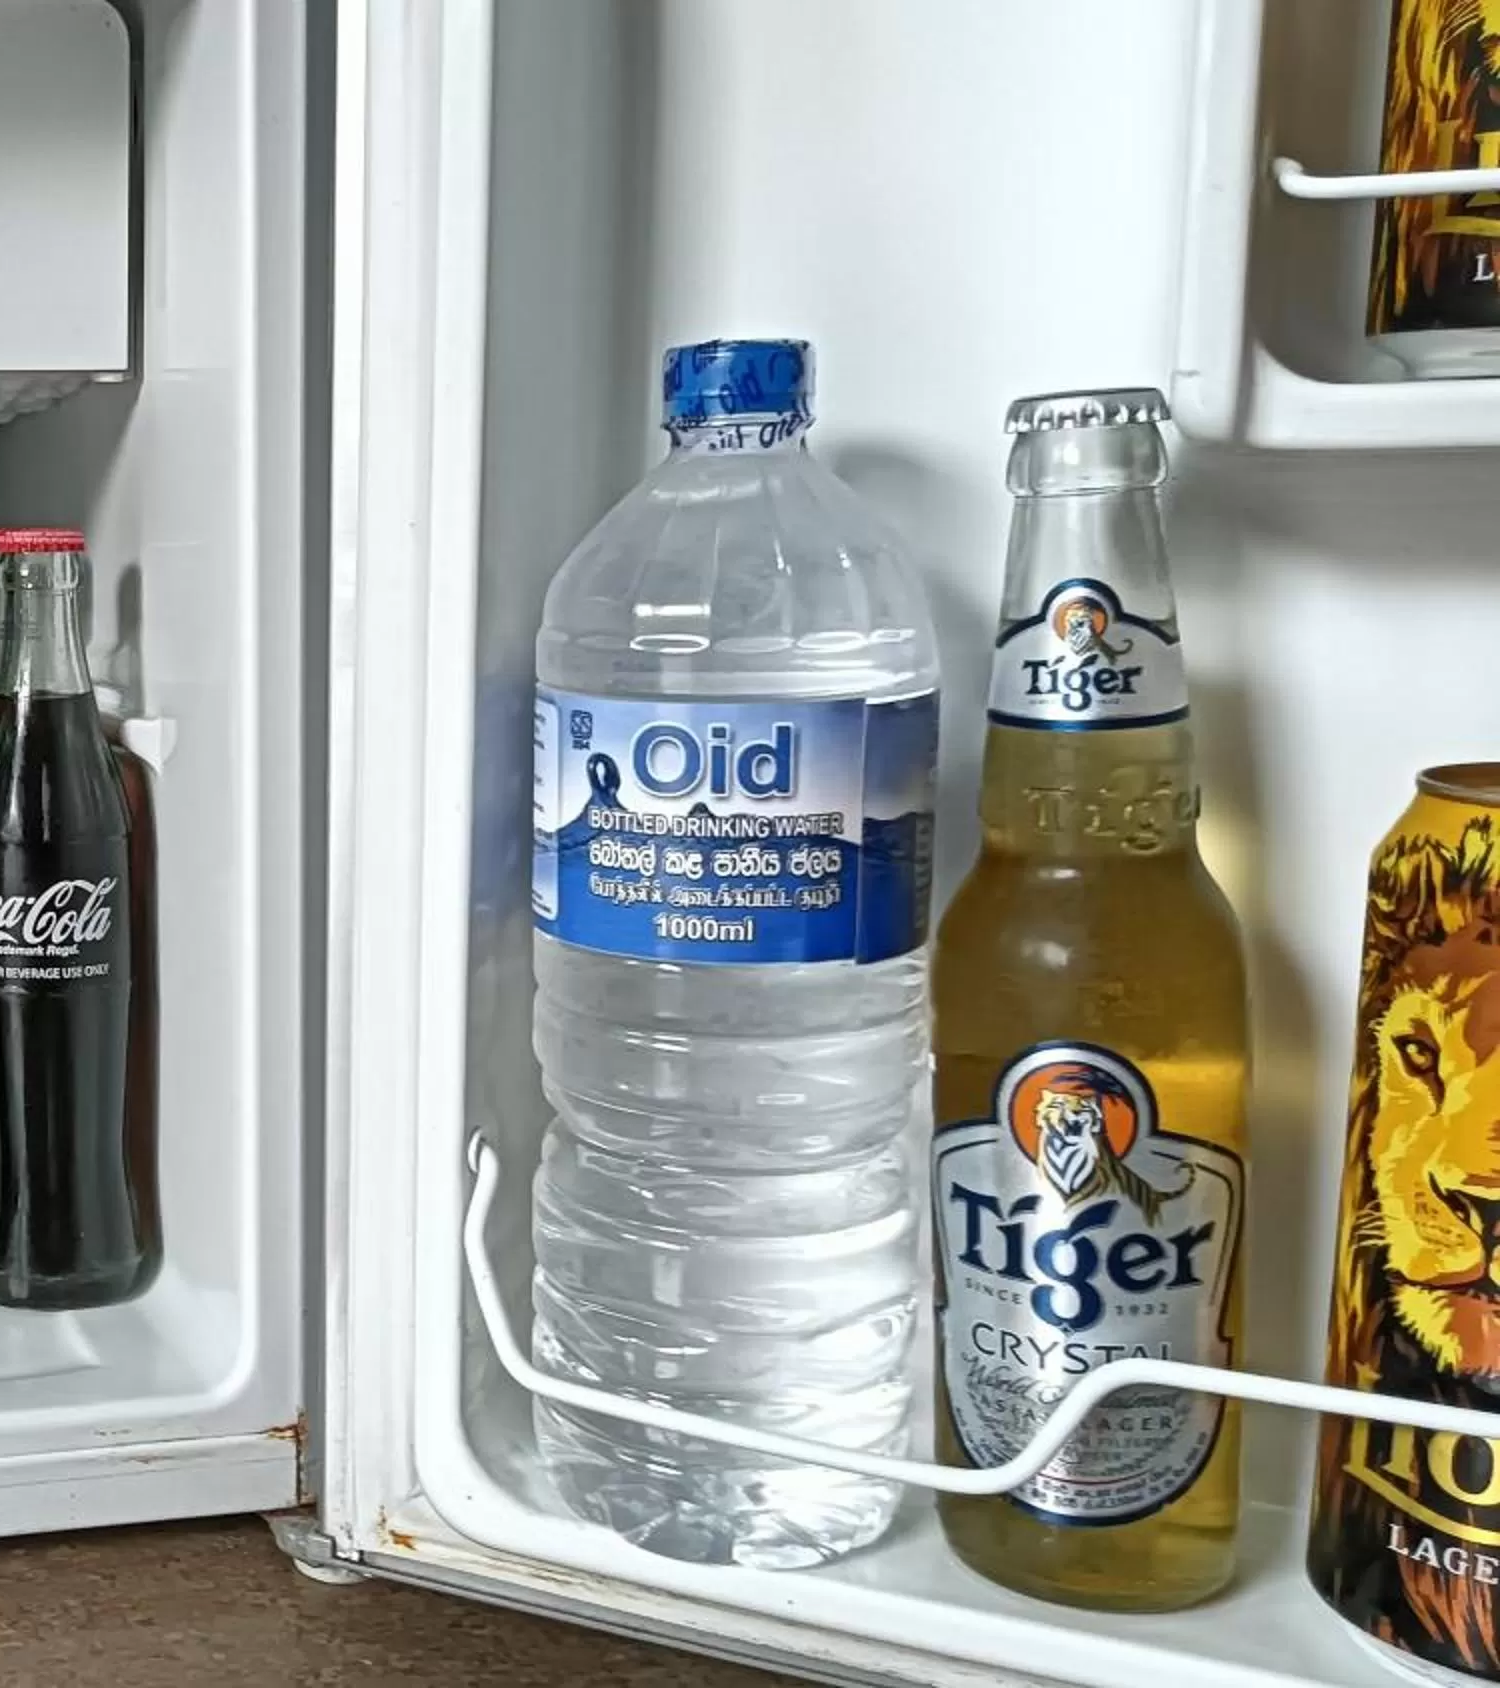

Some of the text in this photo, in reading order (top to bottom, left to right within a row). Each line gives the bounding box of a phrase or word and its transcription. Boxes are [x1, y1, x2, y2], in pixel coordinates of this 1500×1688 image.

[1022, 653, 1144, 712] Tiger
[630, 721, 795, 799] Oid
[589, 807, 845, 839] BOTTLED DRINKING WATER
[653, 914, 754, 942] 1000ml
[5, 964, 61, 980] BEVERAGE
[62, 963, 83, 979] USE
[949, 1181, 1217, 1332] Tiger
[965, 1277, 1170, 1317] SINCE 1932
